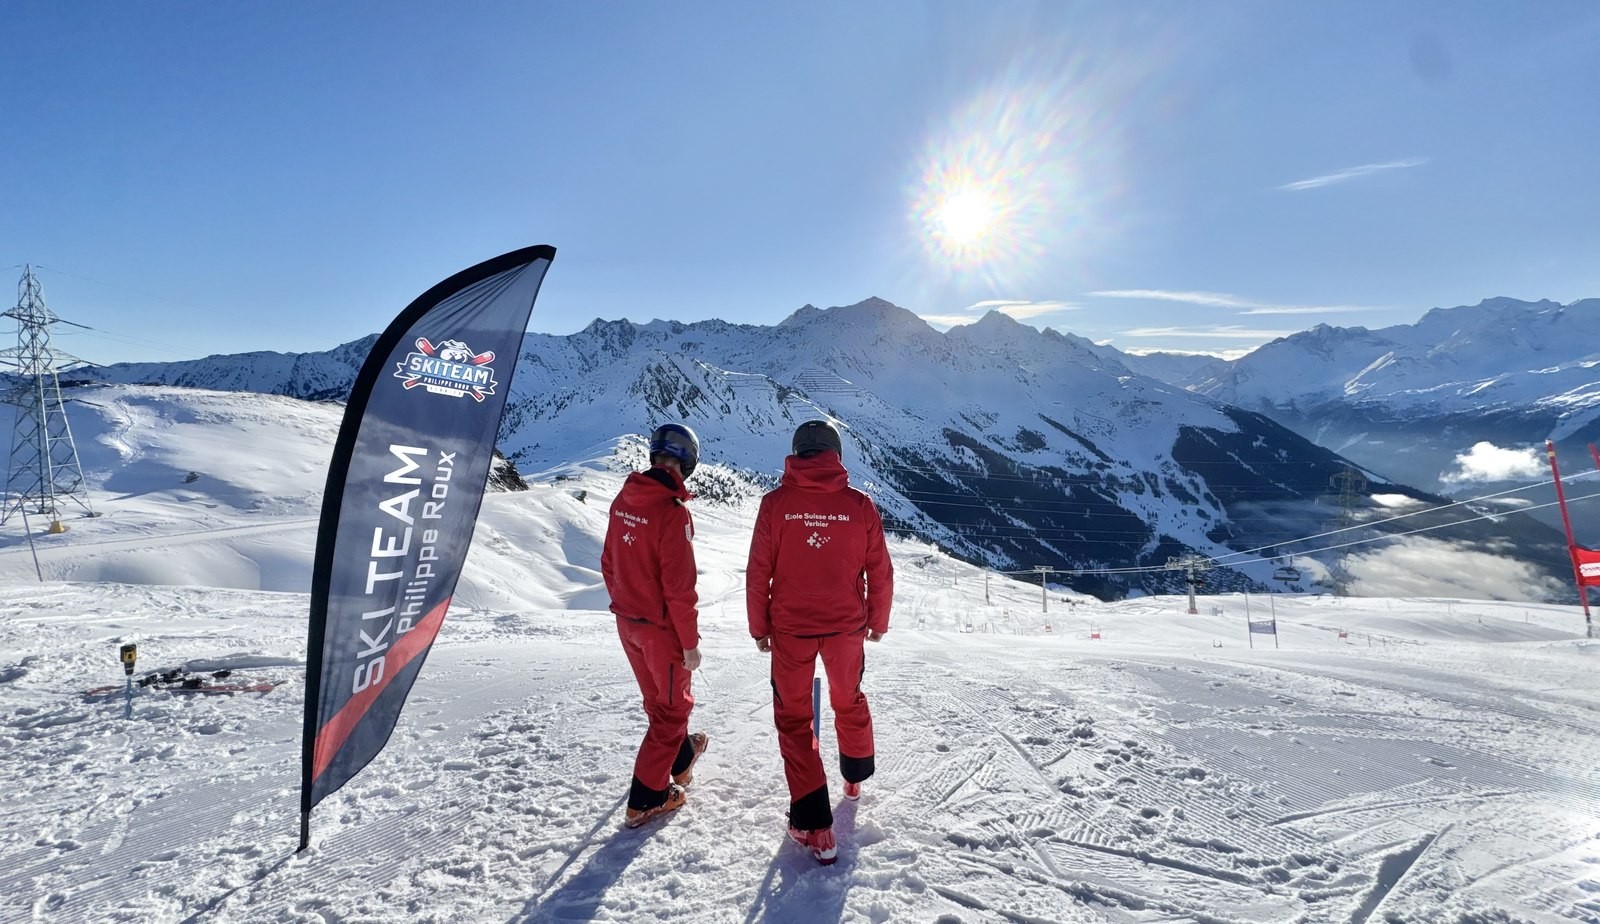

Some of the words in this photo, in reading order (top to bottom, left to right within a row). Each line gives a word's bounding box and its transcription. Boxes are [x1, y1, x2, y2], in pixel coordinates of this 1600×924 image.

[410, 357, 488, 384] SKITEAM
[365, 444, 428, 594] TEAM
[396, 528, 439, 634] Philippe
[422, 450, 457, 519] Roux
[352, 605, 396, 695] SKI
